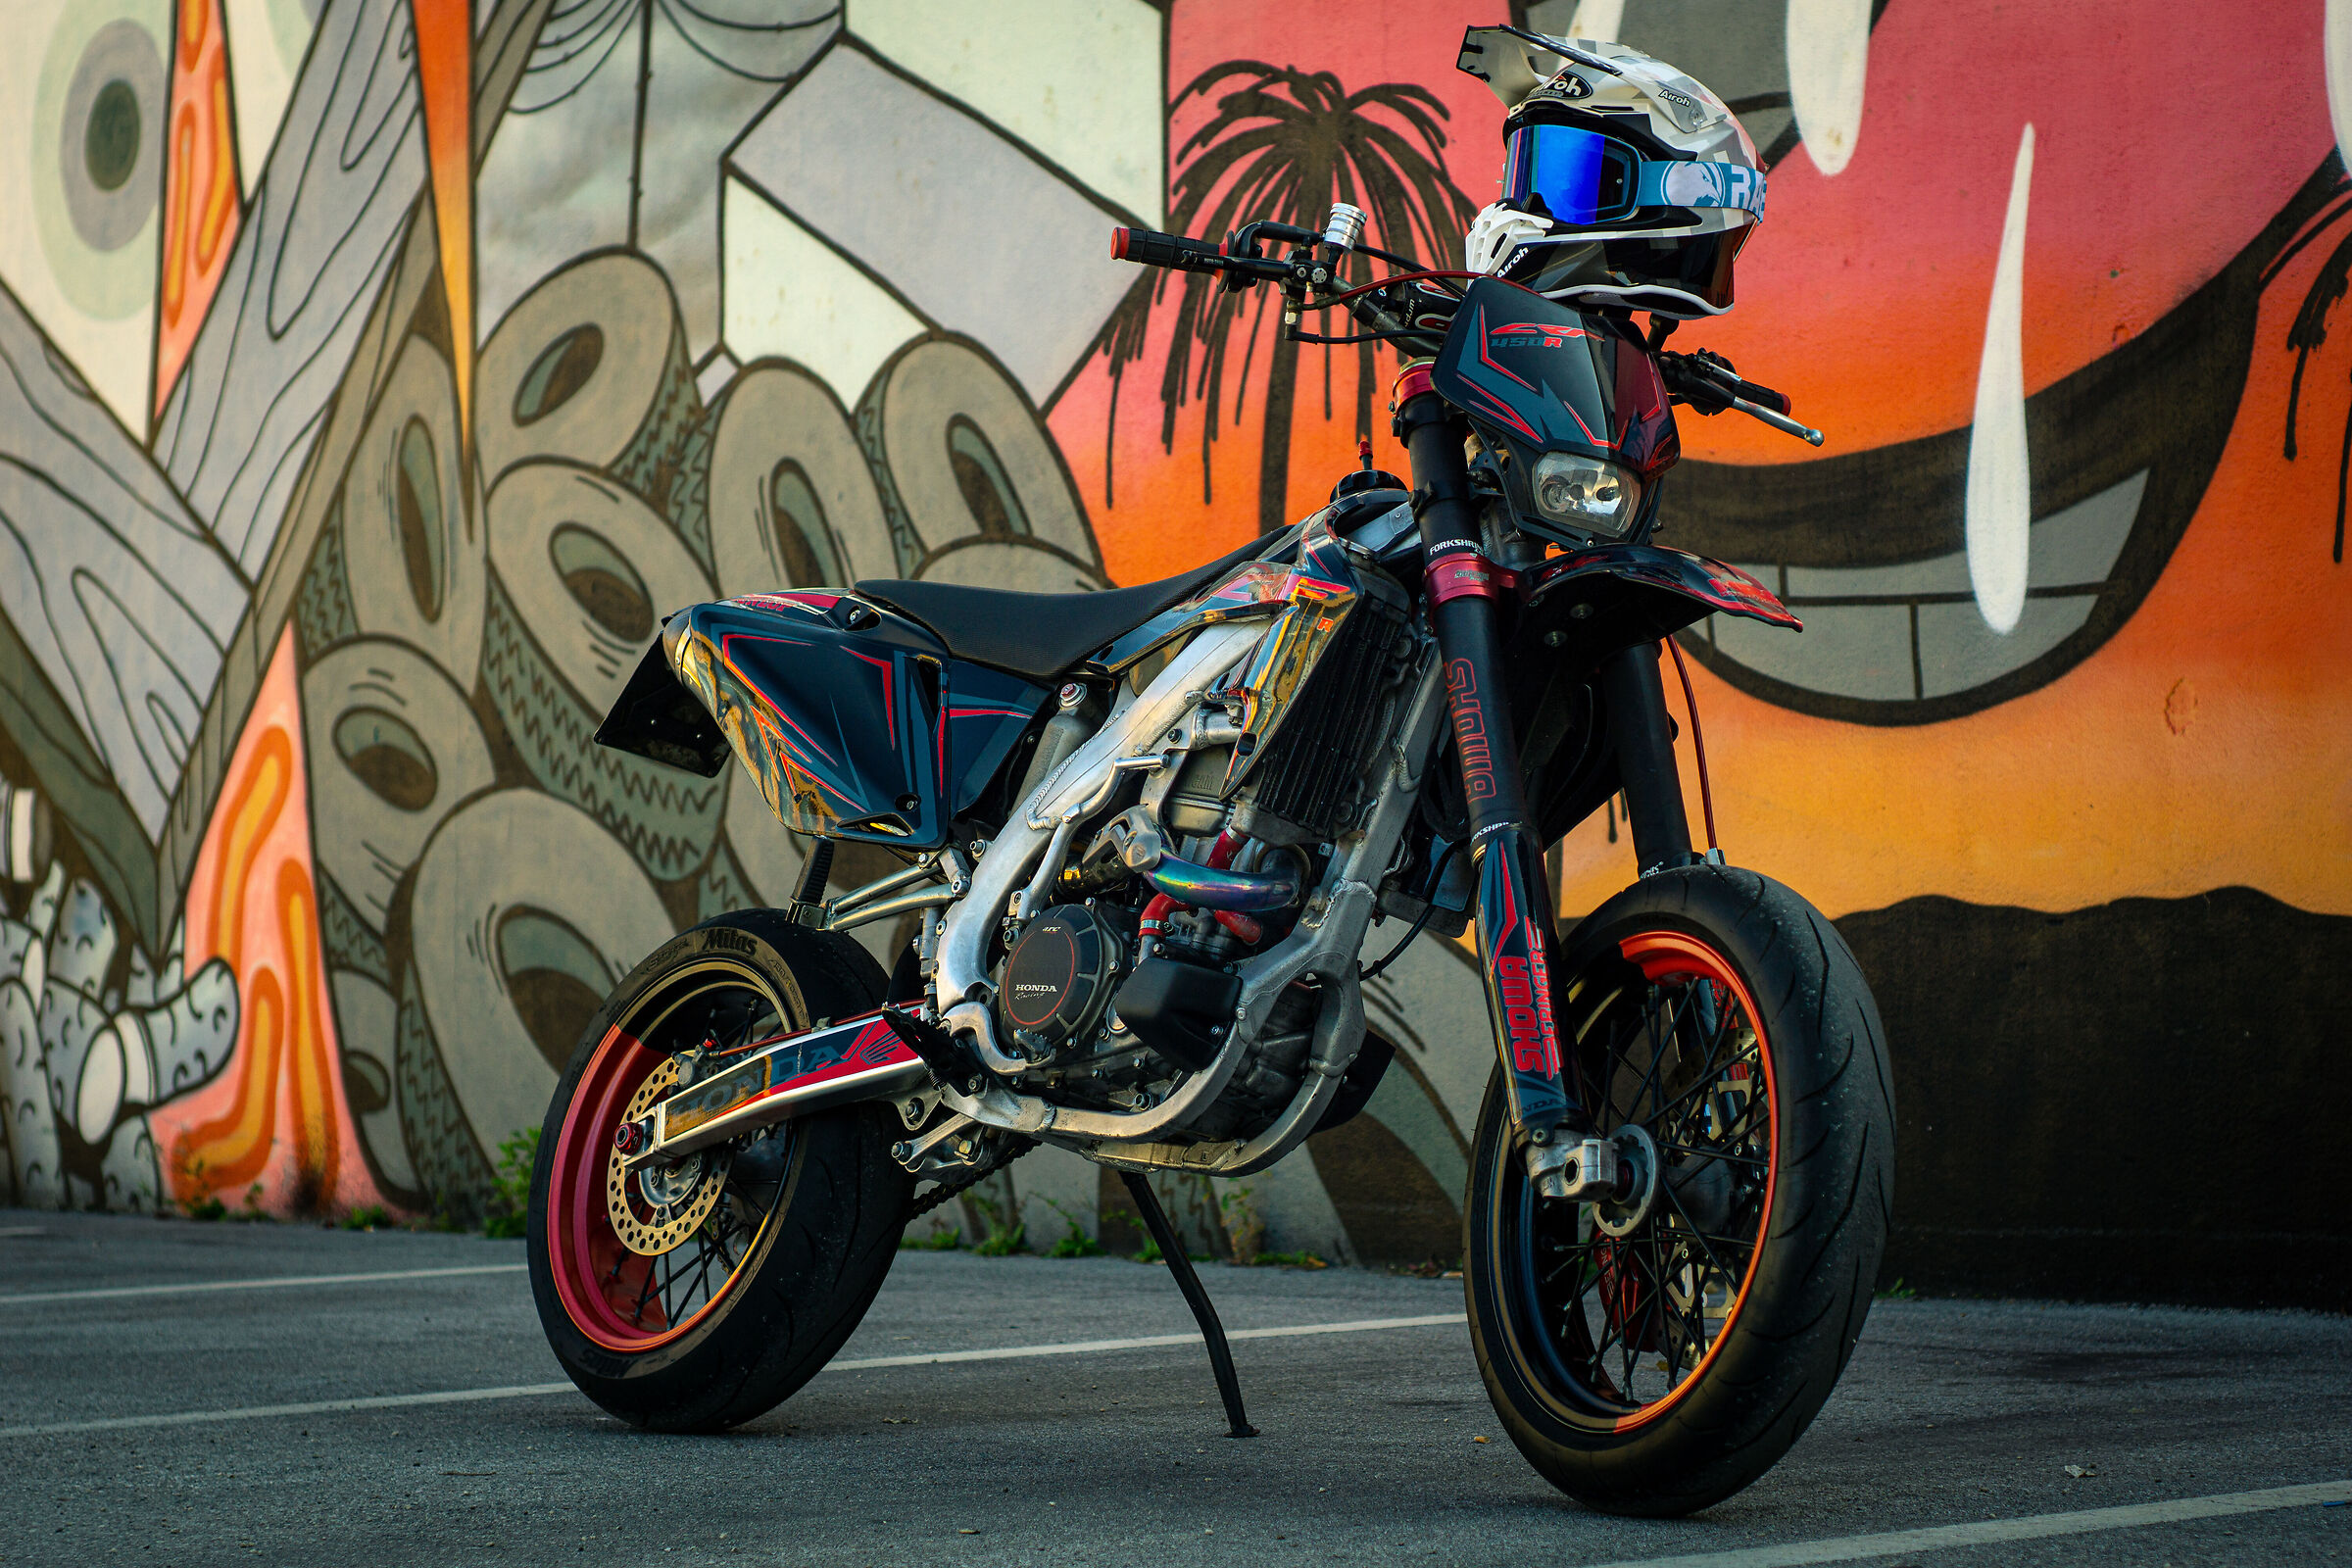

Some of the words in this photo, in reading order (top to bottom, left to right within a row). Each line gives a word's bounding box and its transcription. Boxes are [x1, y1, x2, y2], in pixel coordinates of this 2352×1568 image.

[1658, 89, 1690, 107] Airoh
[1445, 658, 1496, 804] SHOWA
[1498, 956, 1545, 1072] SHOWA
